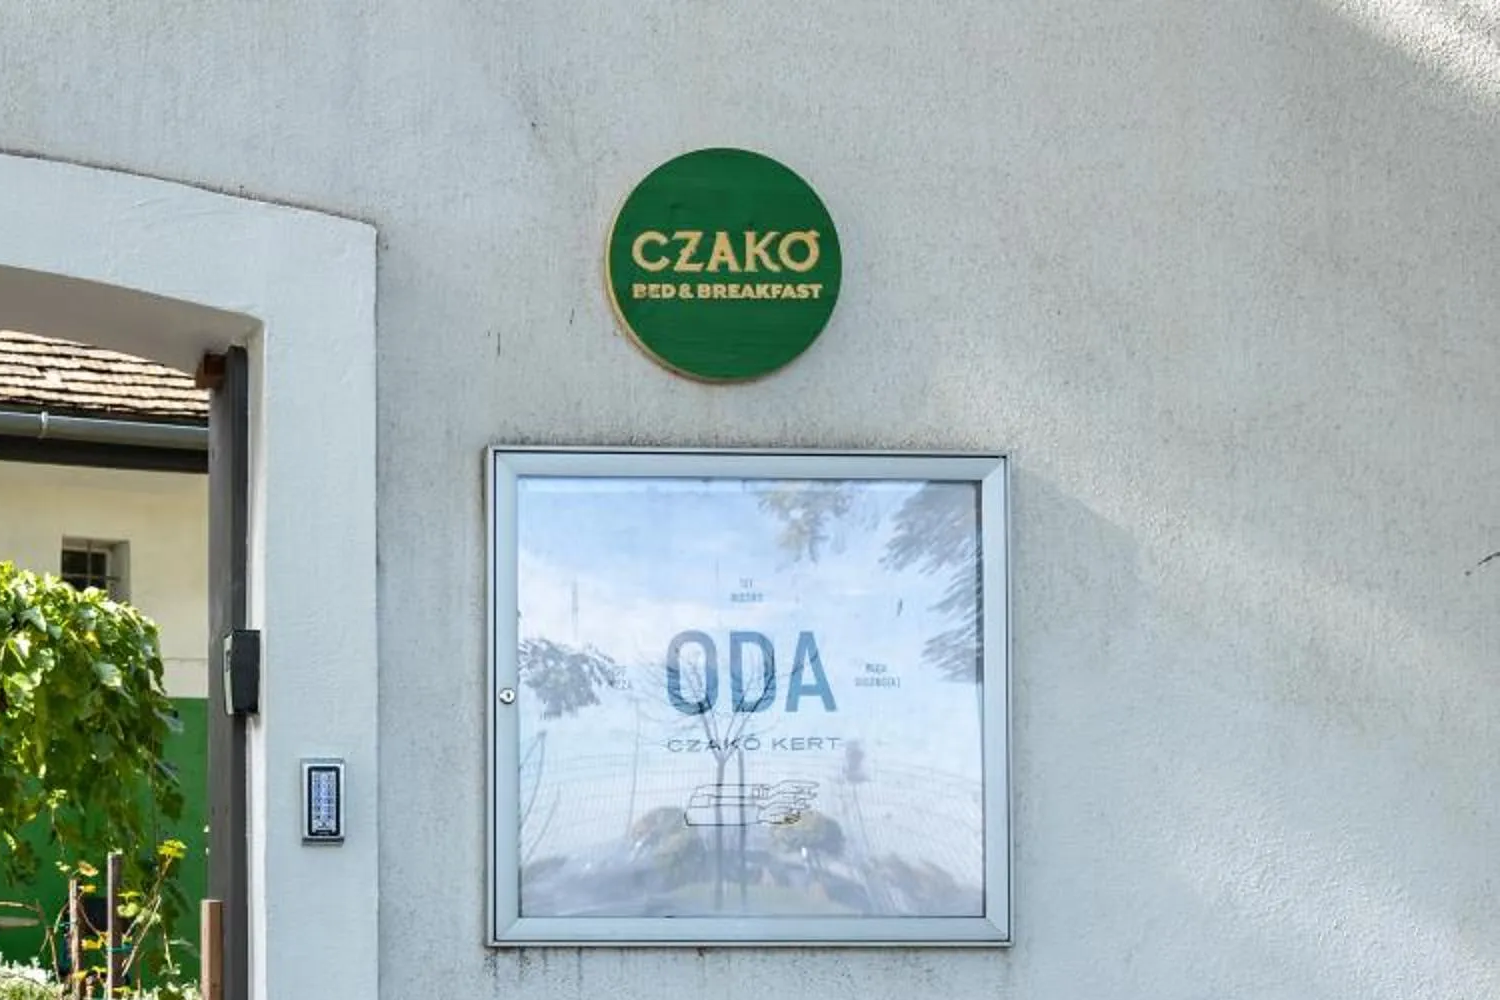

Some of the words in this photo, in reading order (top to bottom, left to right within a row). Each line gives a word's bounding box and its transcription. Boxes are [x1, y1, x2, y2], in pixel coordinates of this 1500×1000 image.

[633, 283, 677, 299] BED
[678, 283, 694, 299] &
[698, 283, 823, 299] BREAKFAST
[666, 630, 838, 716] ODA
[772, 736, 841, 751] KERT
